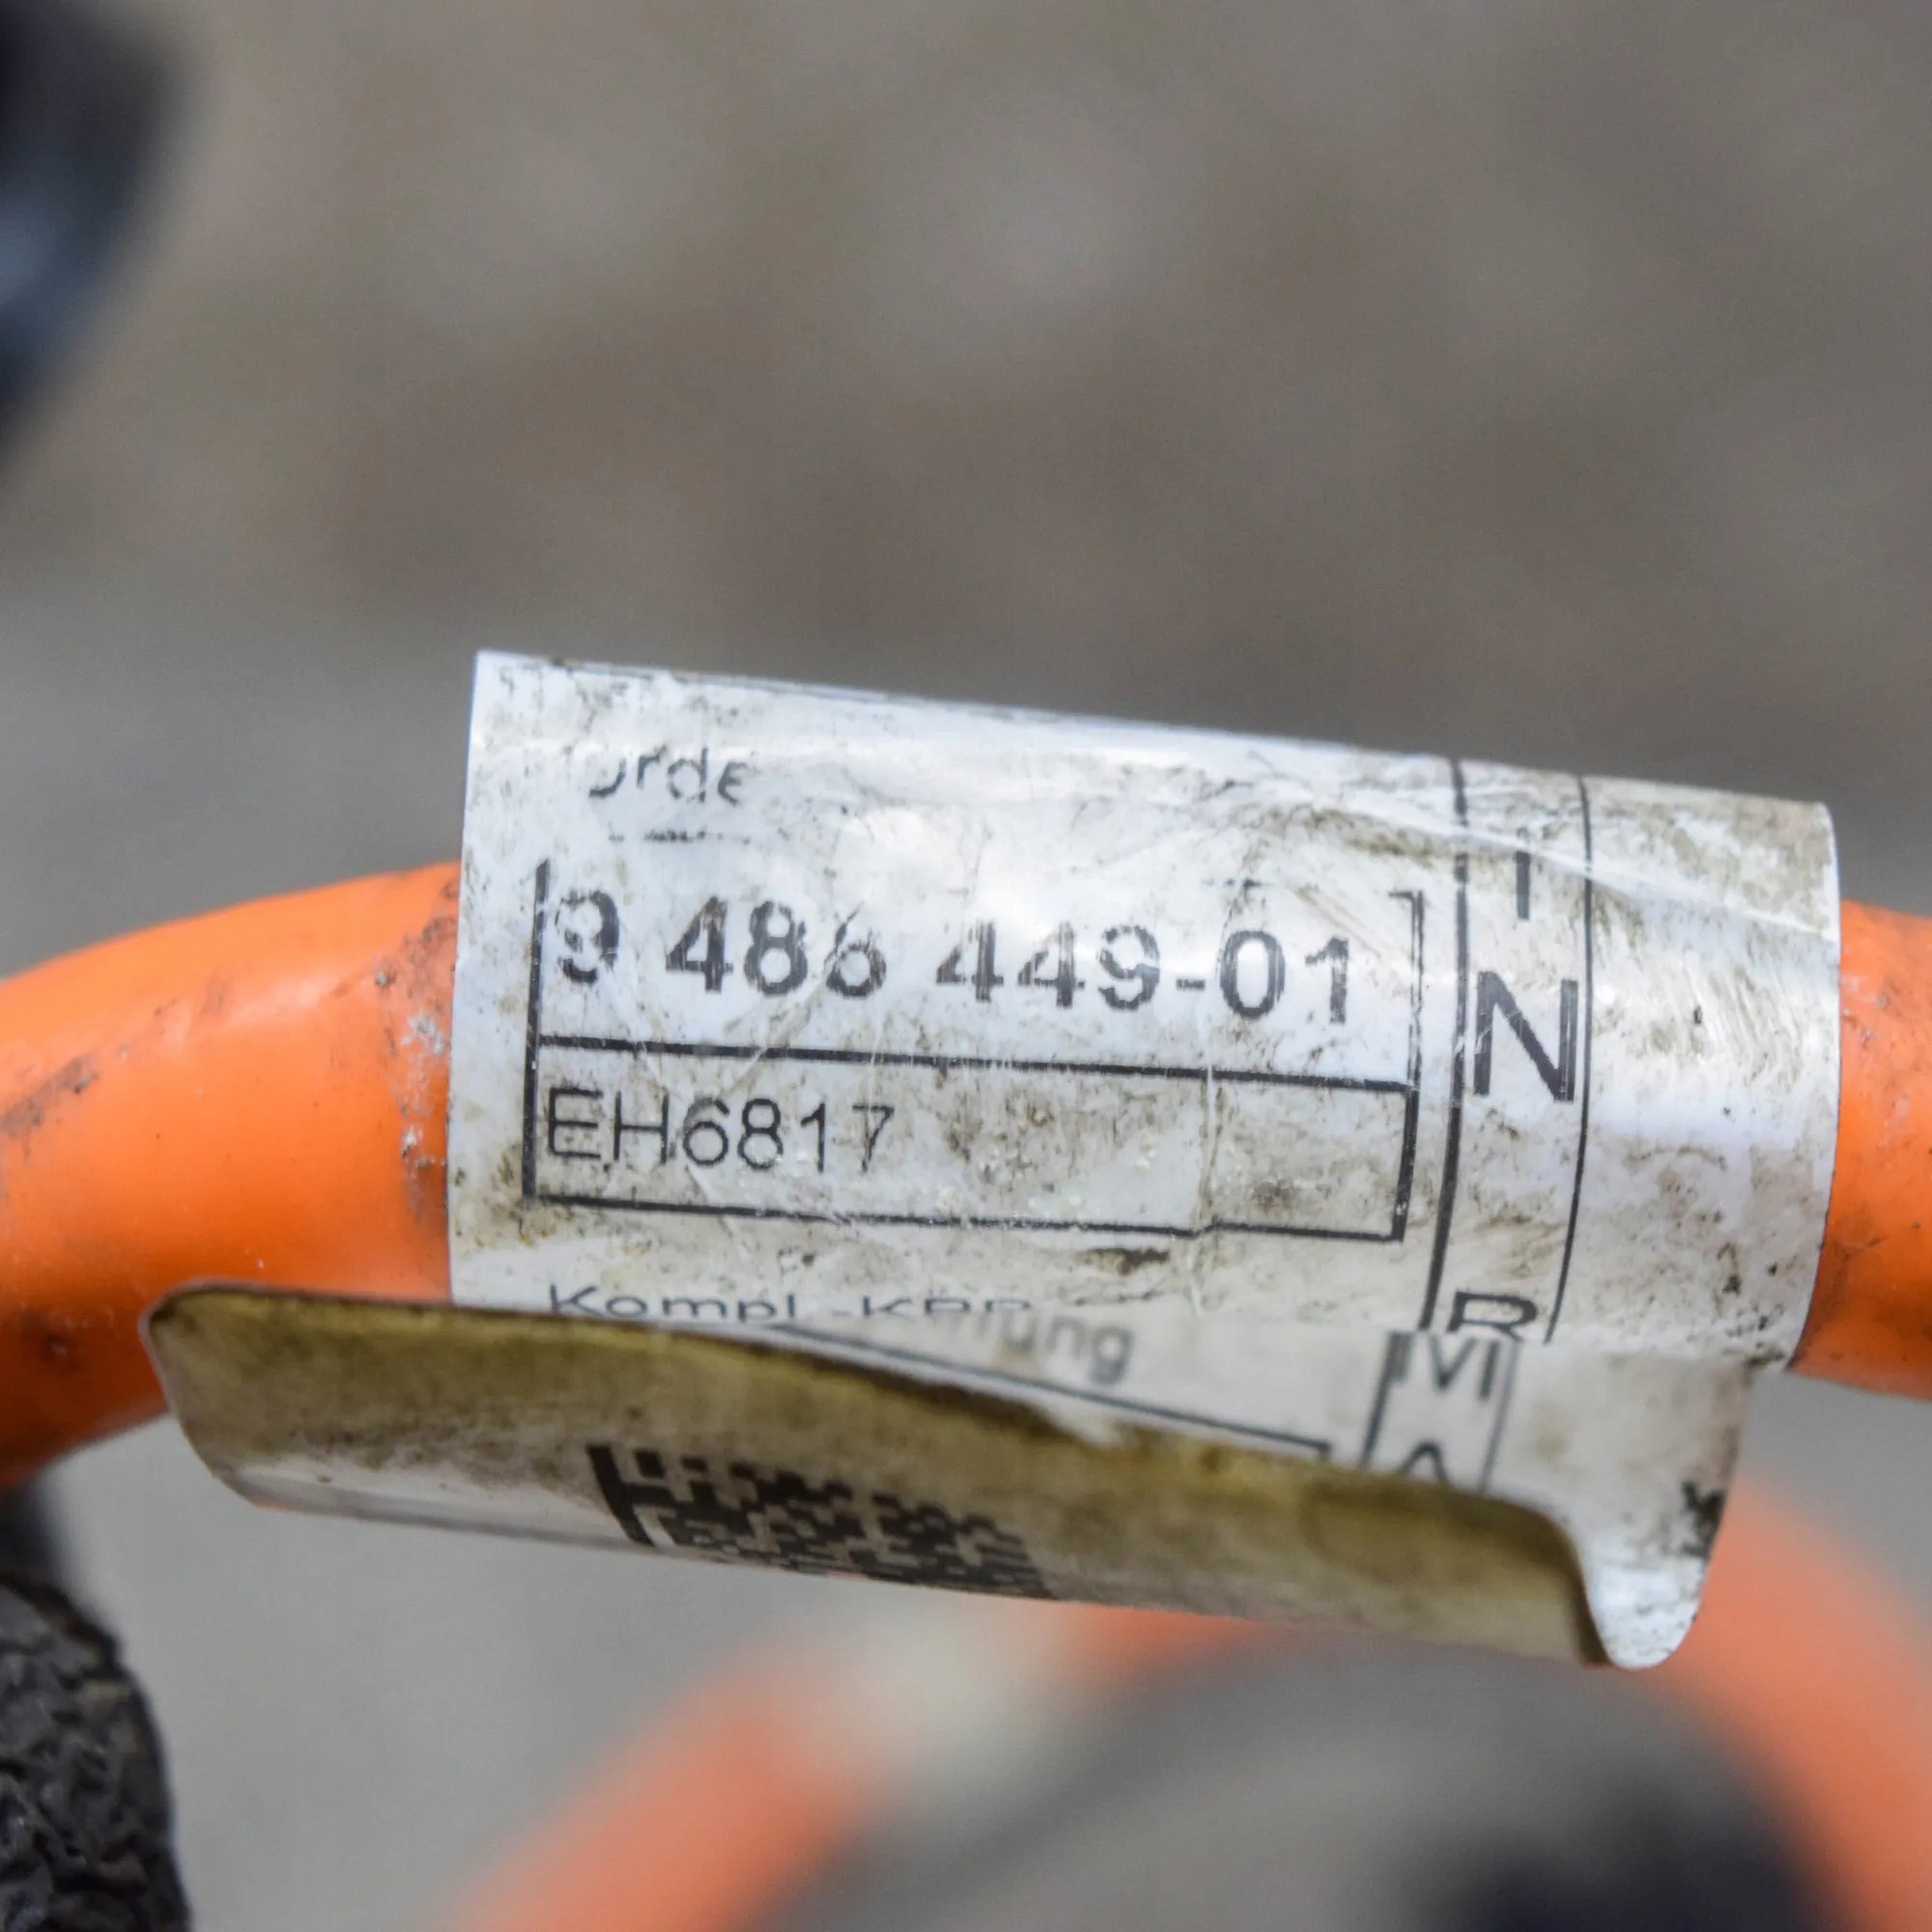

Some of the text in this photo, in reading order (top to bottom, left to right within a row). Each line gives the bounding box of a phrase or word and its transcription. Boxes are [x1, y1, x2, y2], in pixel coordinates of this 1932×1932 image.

[664, 895, 888, 999] 486
[934, 918, 1351, 1026] 449-01
[547, 1084, 896, 1176] EH6817
